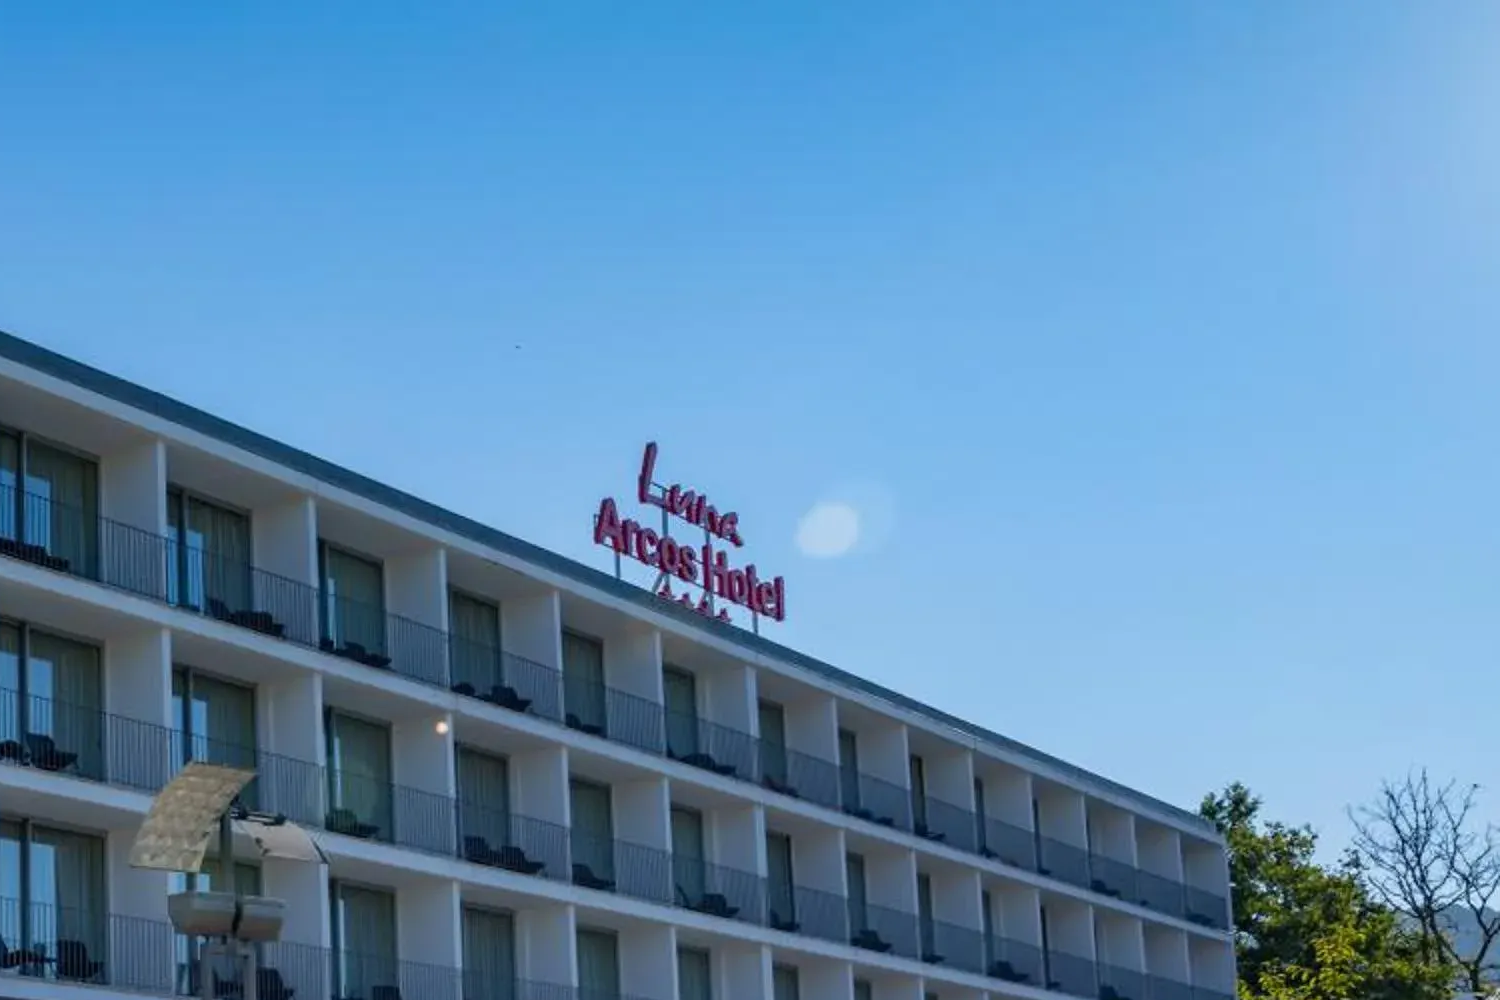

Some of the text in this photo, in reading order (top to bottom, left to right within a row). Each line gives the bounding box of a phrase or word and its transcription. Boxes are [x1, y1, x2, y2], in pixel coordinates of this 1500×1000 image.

[638, 441, 744, 547] Luna
[594, 497, 785, 621] Arcos Hotel
